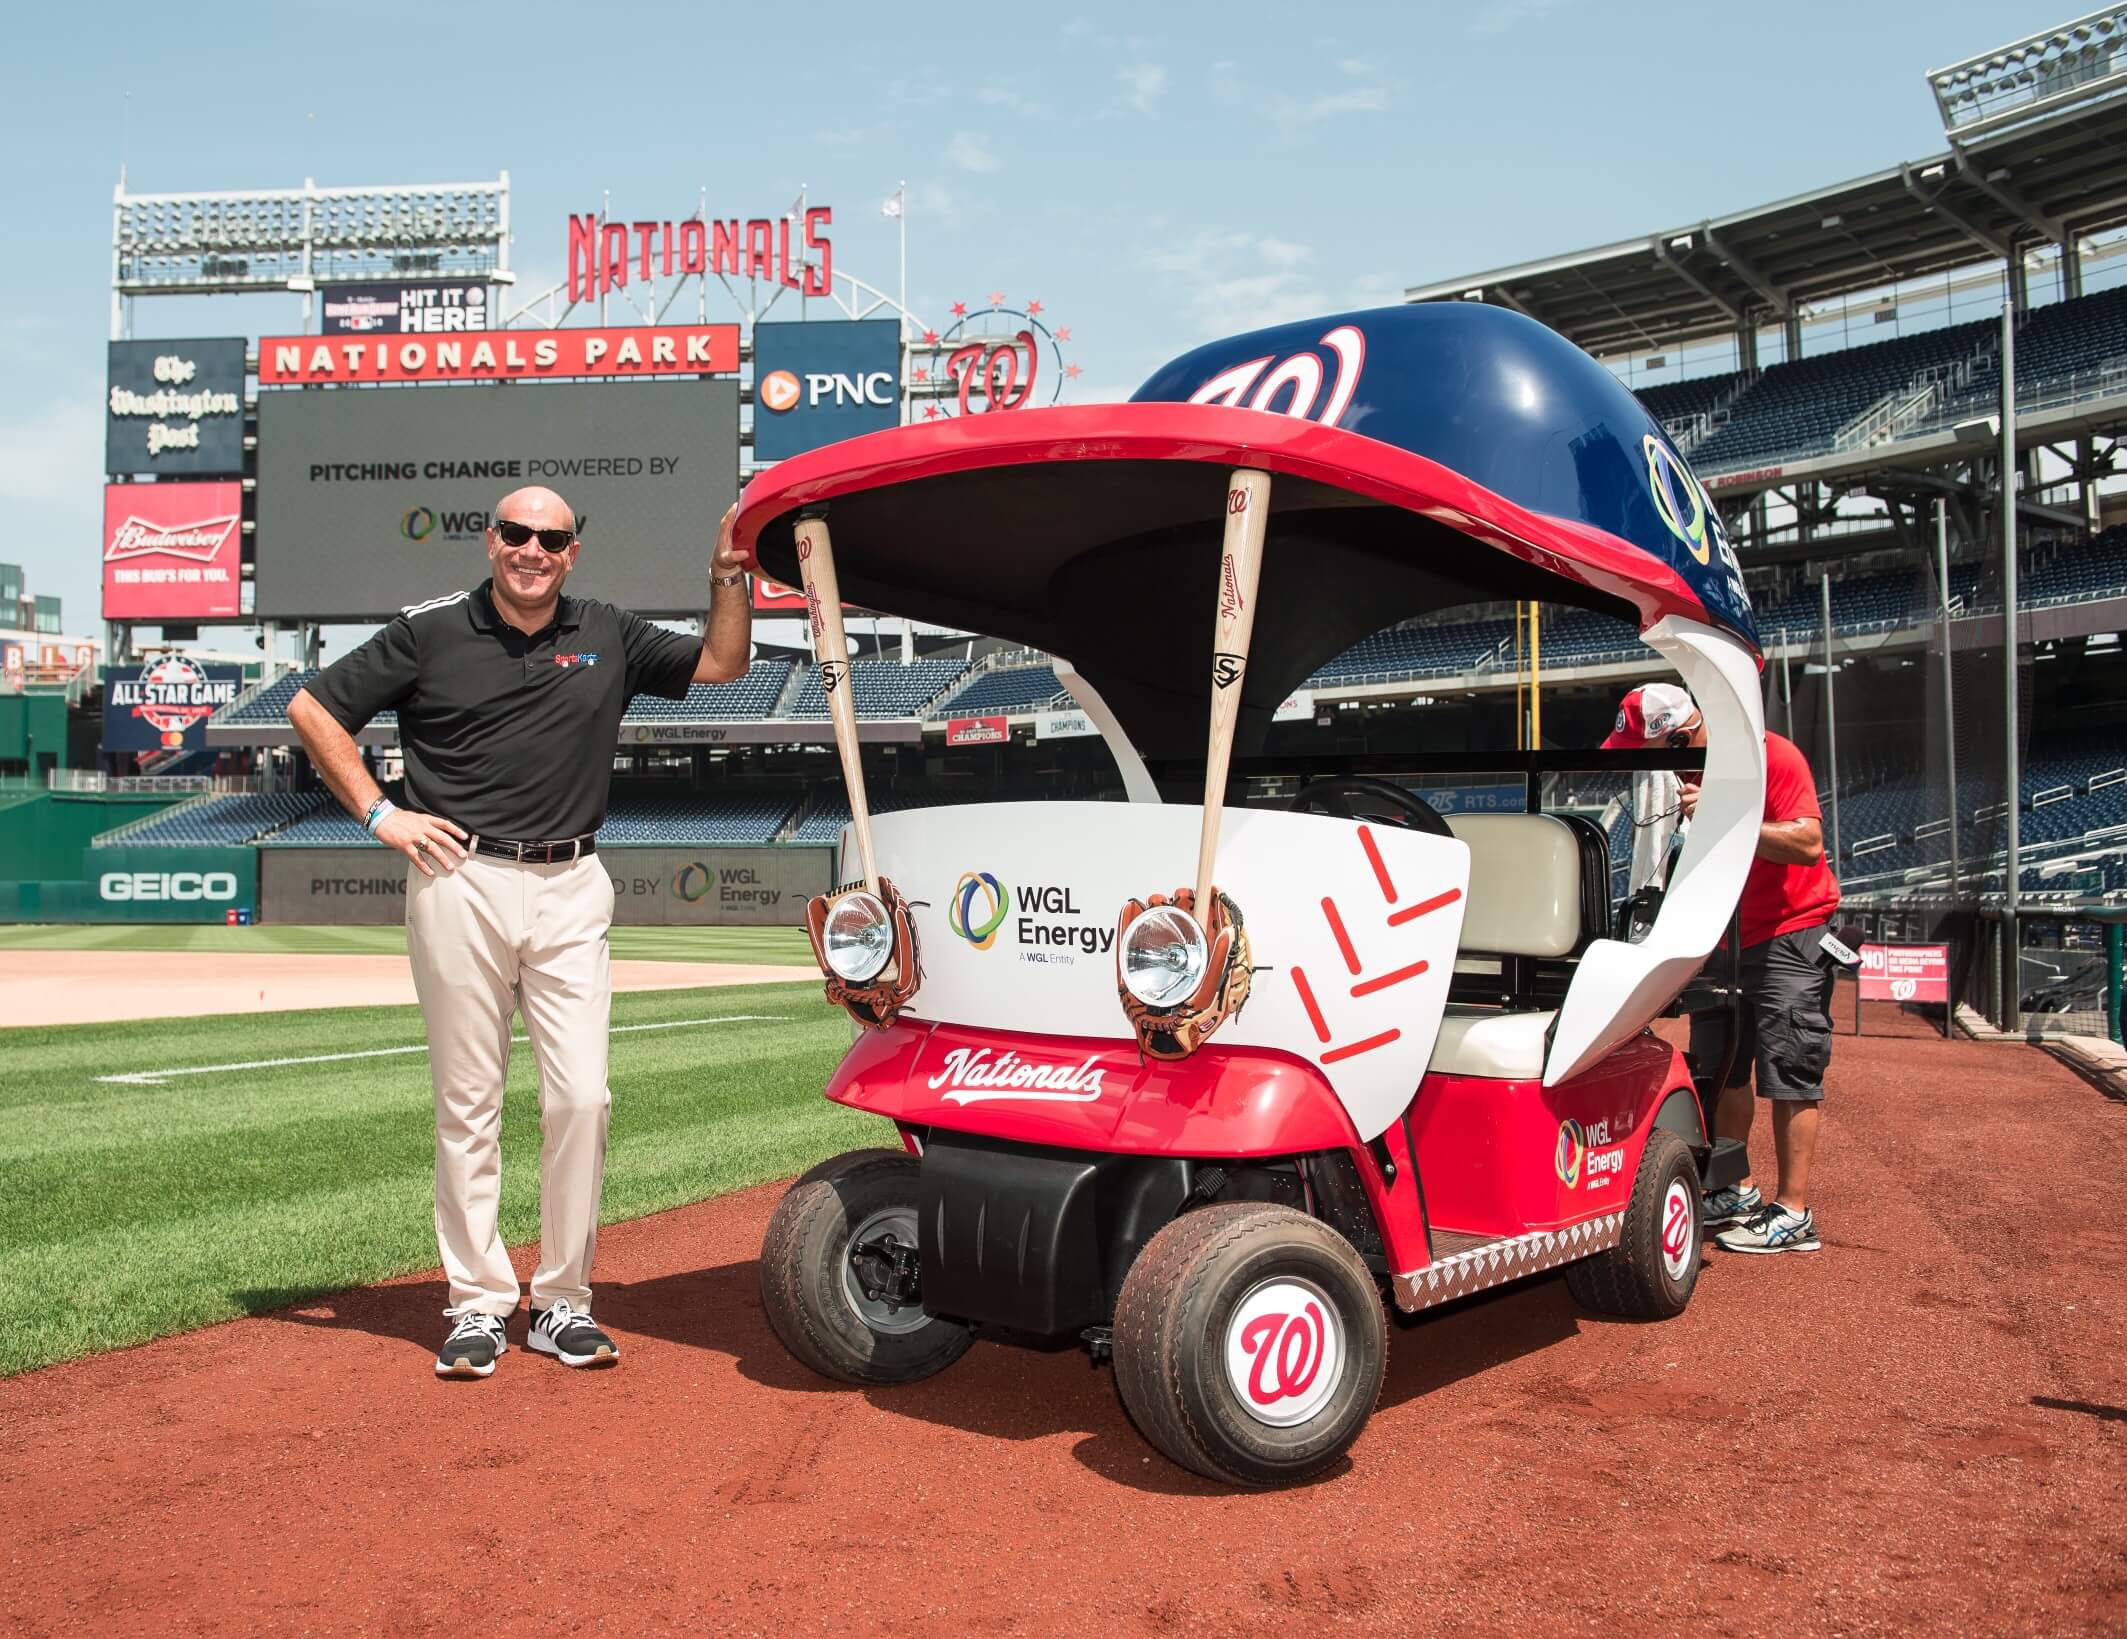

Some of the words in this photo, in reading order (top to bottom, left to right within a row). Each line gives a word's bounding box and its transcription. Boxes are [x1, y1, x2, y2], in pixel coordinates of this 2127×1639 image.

[568, 206, 832, 303] NATIONALS
[400, 289, 438, 307] HIT
[442, 288, 463, 306] IT
[400, 306, 486, 333] HERE
[275, 339, 559, 373] NATIONALS
[586, 335, 713, 365] PARK
[154, 355, 197, 385] The
[109, 385, 239, 420] Washington
[804, 372, 894, 406] PNC
[147, 422, 200, 456] Post
[309, 462, 417, 482] PITCHING
[423, 460, 521, 480] CHANGE
[528, 457, 643, 477] POWERED
[650, 456, 680, 475] BY
[115, 526, 226, 549] Budweiser
[113, 569, 140, 583] THIS
[178, 568, 201, 582] FOR
[203, 568, 230, 582] YOU.
[1221, 553, 1243, 620] Nationals
[191, 683, 237, 704] GAME
[652, 726, 682, 739] WGL
[683, 725, 727, 743] Energy
[953, 730, 1003, 743] CHAMPIONS
[100, 872, 238, 901] GEICO
[633, 879, 660, 896] BY
[720, 869, 761, 884] WGL
[720, 886, 781, 905] Energy
[1017, 886, 1080, 914] WGL
[1018, 918, 1115, 954] Energy
[1019, 953, 1025, 961] A
[1026, 953, 1048, 963] WGL
[1050, 953, 1075, 966] Entity
[1860, 950, 1884, 970] NO
[928, 1047, 1107, 1106] Nationals
[1585, 1120, 1612, 1148] WGL
[1587, 1148, 1624, 1176] Energy
